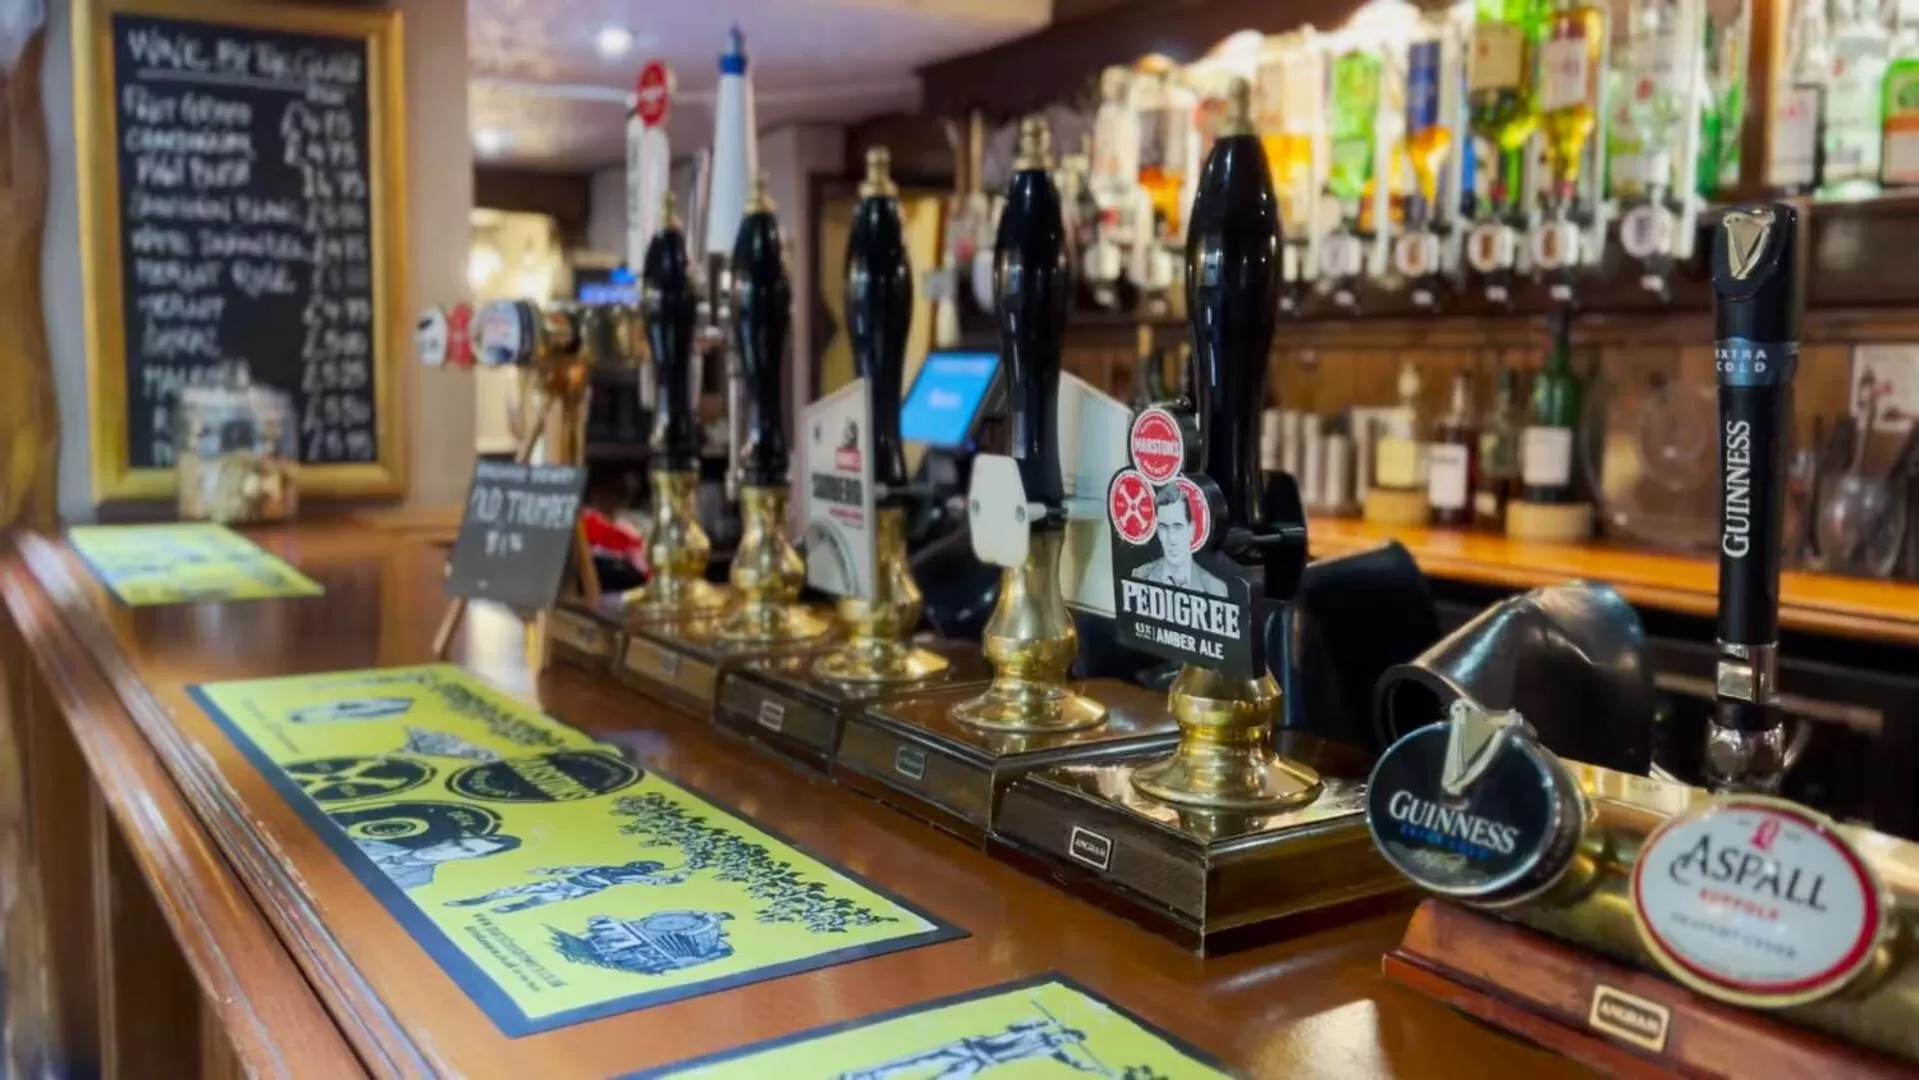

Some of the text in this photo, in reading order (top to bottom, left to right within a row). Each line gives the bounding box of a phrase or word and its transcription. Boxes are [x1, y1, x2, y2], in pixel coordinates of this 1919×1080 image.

[1722, 420, 1751, 559] GUINNESS
[1120, 579, 1241, 640] PEDIGREE
[1156, 628, 1196, 652] AMBER
[1199, 639, 1224, 660] ALE
[1388, 789, 1521, 854] GUINNESS
[1669, 834, 1828, 913] ASPALL
[1600, 1000, 1660, 1034] ANGRAM
